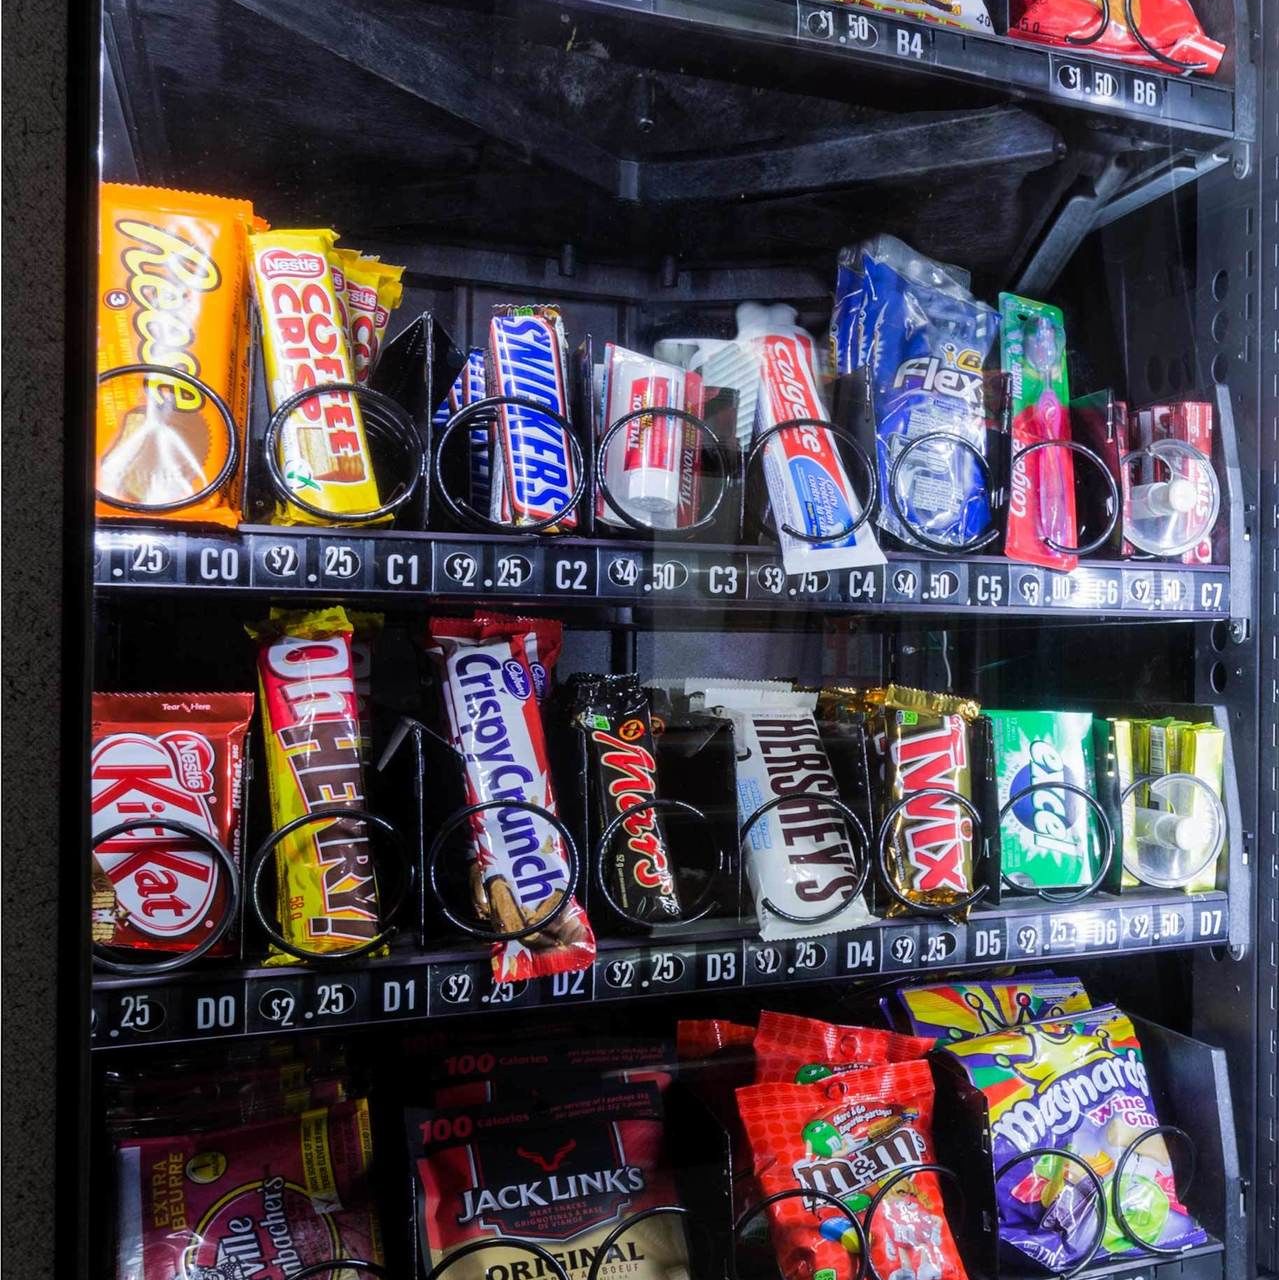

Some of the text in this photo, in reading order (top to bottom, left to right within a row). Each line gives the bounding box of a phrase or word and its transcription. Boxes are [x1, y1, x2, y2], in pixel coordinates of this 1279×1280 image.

[896, 28, 924, 59] B4
[1133, 78, 1157, 106] B6
[110, 292, 127, 308] 3
[116, 220, 222, 412] Reese
[271, 283, 324, 425] CRISP
[301, 285, 364, 456] COFFEE
[892, 357, 983, 405] Flex
[1012, 362, 1022, 400] Twister
[773, 340, 824, 454] Colgate
[500, 316, 575, 519] SNICKERS
[679, 448, 697, 507] TYLENOL
[1008, 439, 1027, 518] Colgate
[199, 547, 240, 580] C0
[270, 544, 354, 583] $2.25
[387, 554, 419, 585] C1
[453, 556, 522, 588] $2.25
[555, 559, 588, 590] C2
[615, 560, 676, 593] $4.50
[708, 566, 738, 594] C3
[765, 566, 819, 596] $3.75
[849, 570, 876, 597] C4
[897, 572, 950, 600] $4.50
[977, 575, 1002, 601] C5
[1095, 577, 1118, 604] C6
[1201, 582, 1224, 608] C7
[267, 638, 355, 718] Oh
[162, 702, 211, 712] Tear Here
[592, 730, 674, 895] Mars
[753, 718, 859, 903] HERSHEY'S
[1029, 739, 1083, 859] excel
[1019, 921, 1067, 954] $2.25
[1094, 923, 1118, 945] D6
[1133, 912, 1179, 940] $2.50
[1200, 910, 1222, 936] D7
[755, 940, 817, 974] $2.25
[846, 940, 875, 968] D4
[896, 936, 947, 963] $2.25
[975, 930, 1001, 956] D5
[613, 954, 675, 988] $2.25
[706, 952, 736, 982] D3
[384, 981, 416, 1011] D1
[450, 975, 514, 1004] $2.25
[553, 970, 586, 997] D2
[196, 997, 236, 1030] D0
[271, 983, 344, 1027] $2.25
[446, 1053, 495, 1076] 100
[419, 1115, 473, 1144] 100
[155, 1158, 170, 1229] EXTRA
[171, 1151, 185, 1231] BEURRE
[459, 1164, 646, 1223] JACK LINK'S
[602, 1263, 640, 1276] BOEUF
